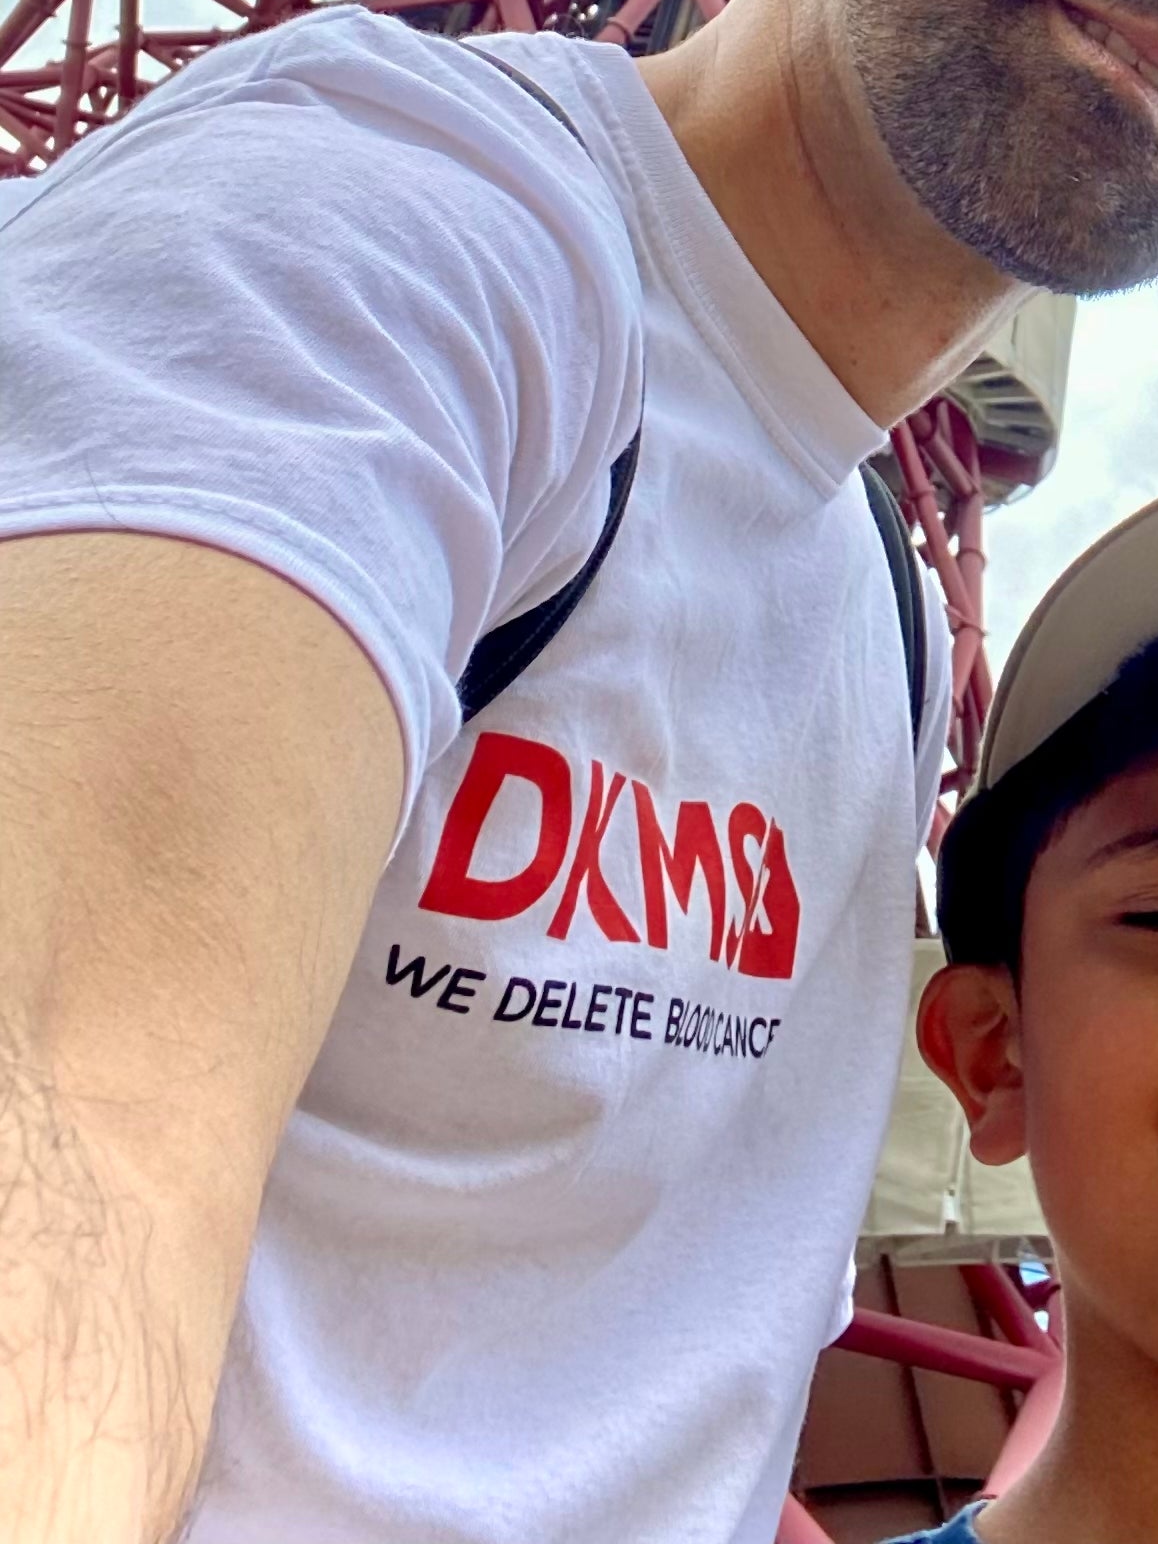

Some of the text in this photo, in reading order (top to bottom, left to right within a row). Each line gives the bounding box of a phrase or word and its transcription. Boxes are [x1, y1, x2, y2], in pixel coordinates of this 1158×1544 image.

[418, 731, 768, 971] DKMS
[385, 943, 487, 1014] WE
[493, 976, 653, 1041] DELETE
